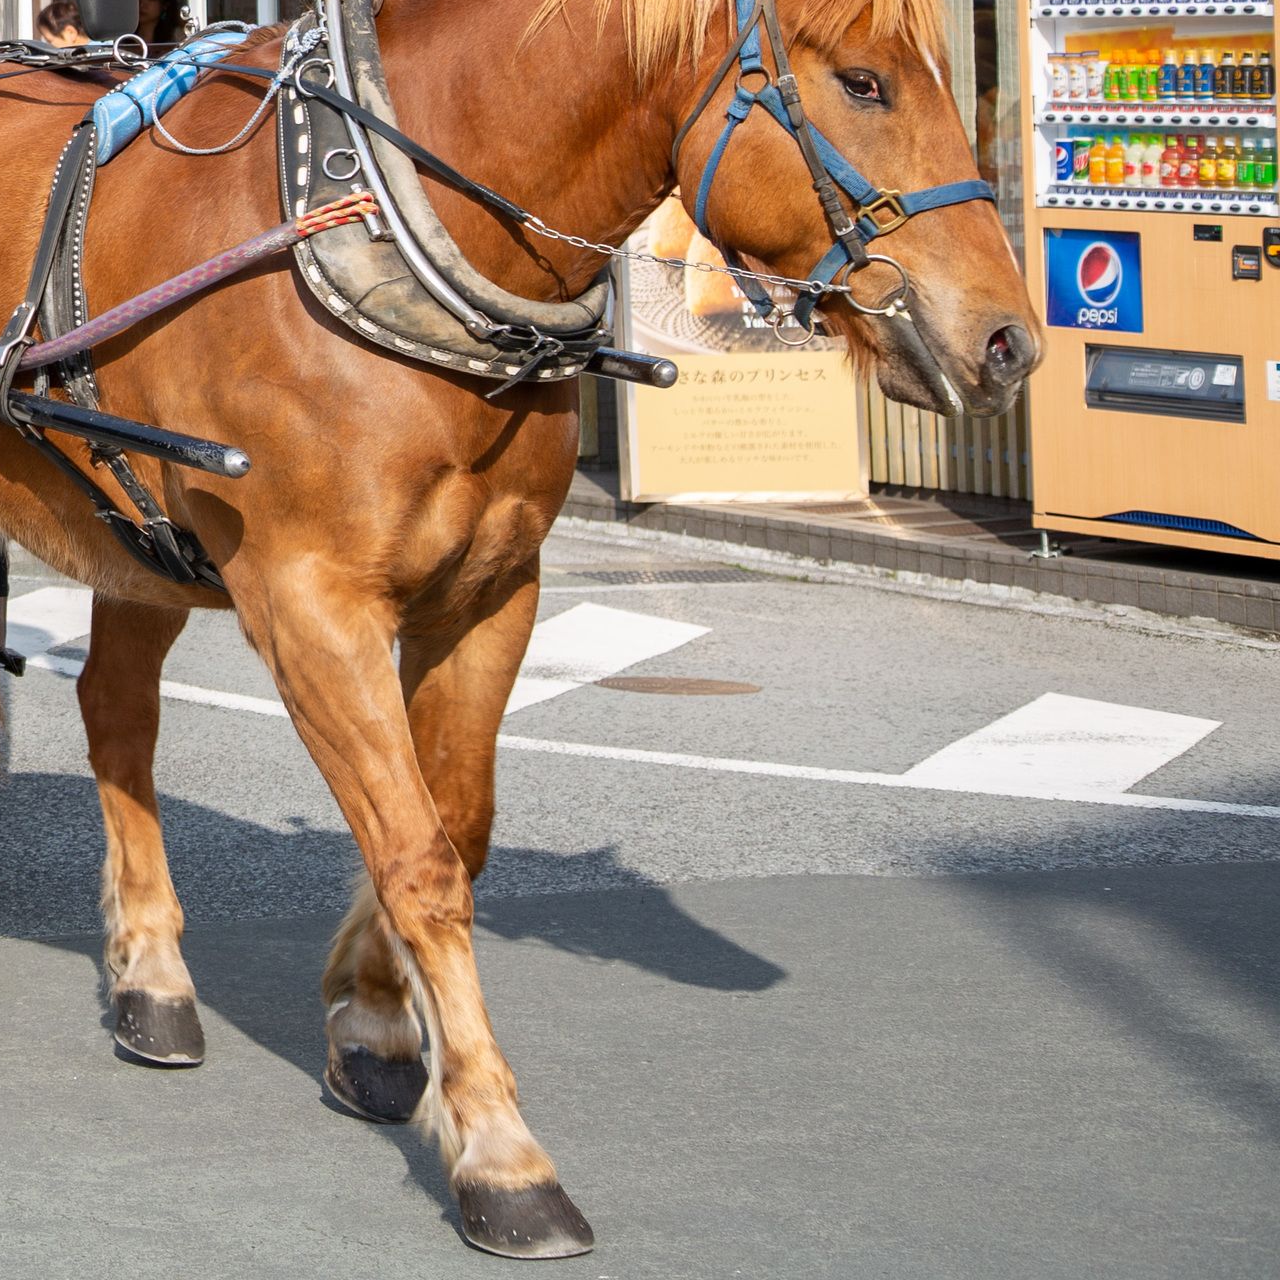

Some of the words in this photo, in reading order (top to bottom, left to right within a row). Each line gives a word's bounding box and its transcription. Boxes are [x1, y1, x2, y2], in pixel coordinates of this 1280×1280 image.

[1078, 307, 1118, 326] pepsi
[678, 367, 827, 385] さな森のプリンセス
